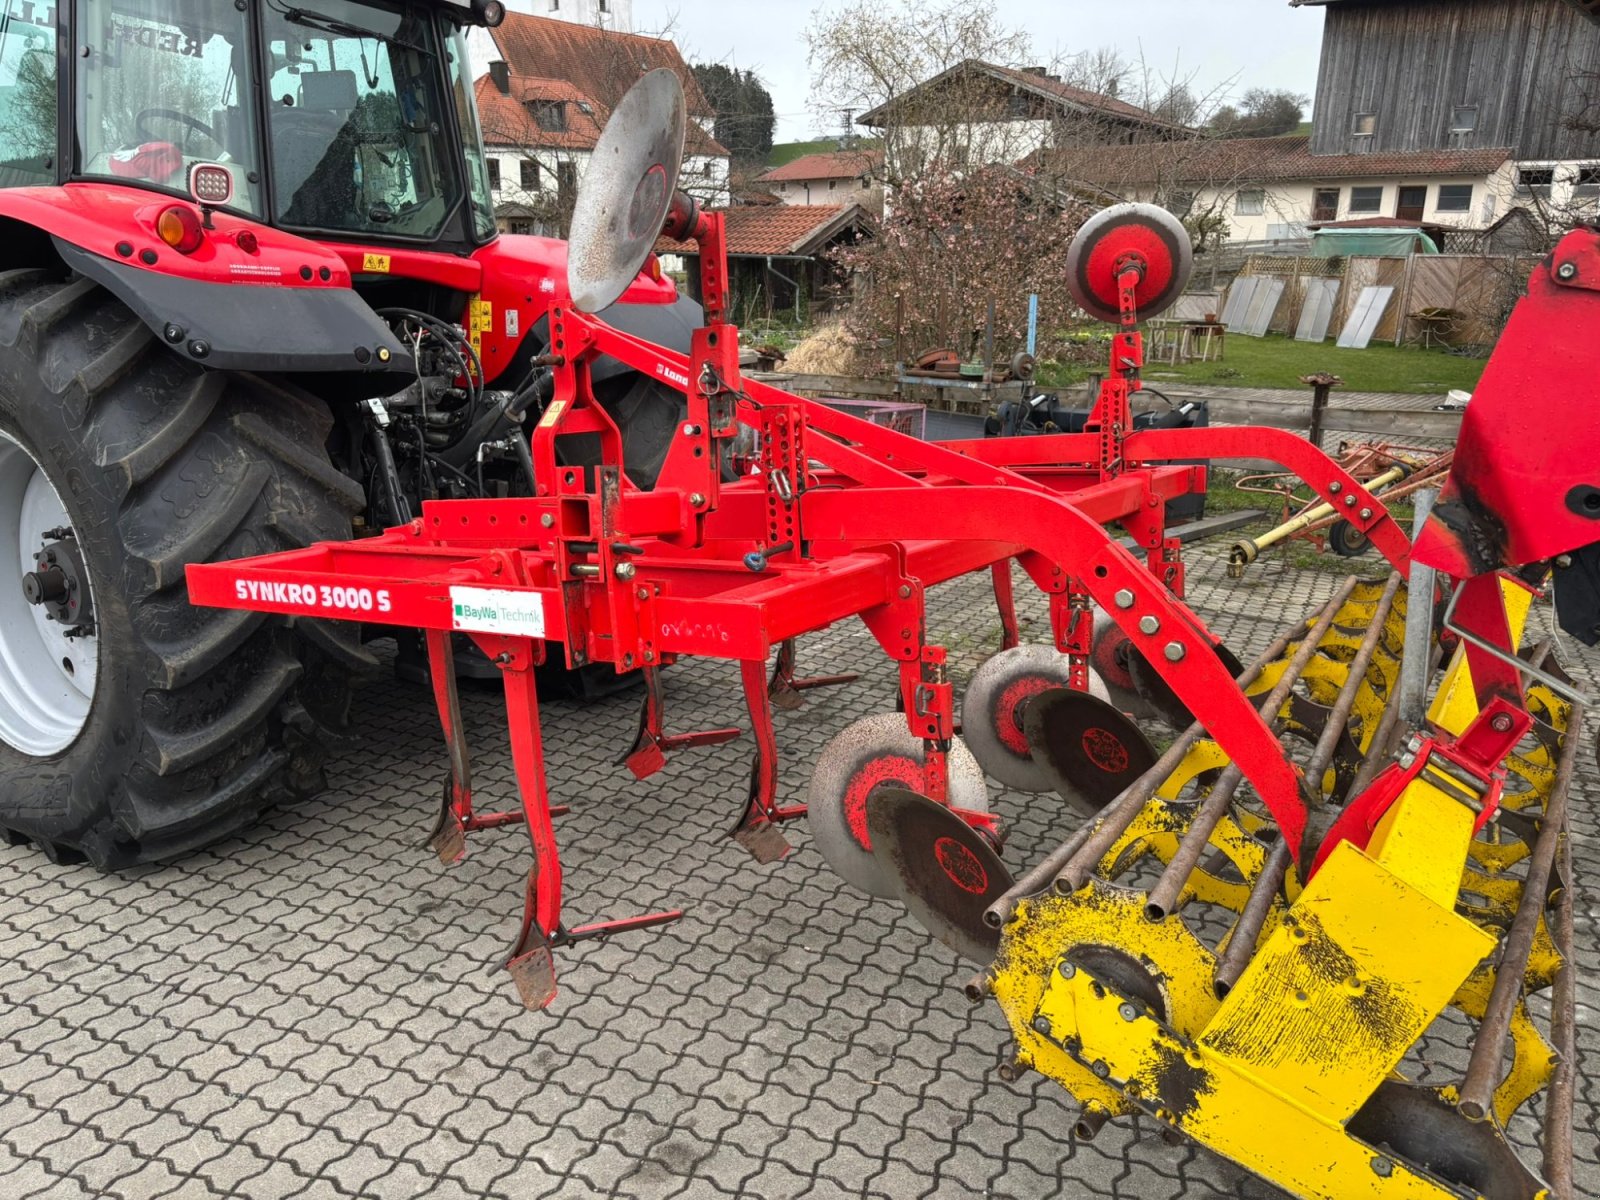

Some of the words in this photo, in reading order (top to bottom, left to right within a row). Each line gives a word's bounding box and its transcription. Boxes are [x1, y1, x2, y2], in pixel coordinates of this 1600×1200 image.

[235, 579, 316, 605] SYNKRO
[320, 586, 373, 610] 3000
[376, 590, 391, 612] S
[463, 604, 497, 621] BayWa
[500, 607, 541, 623] Technik
